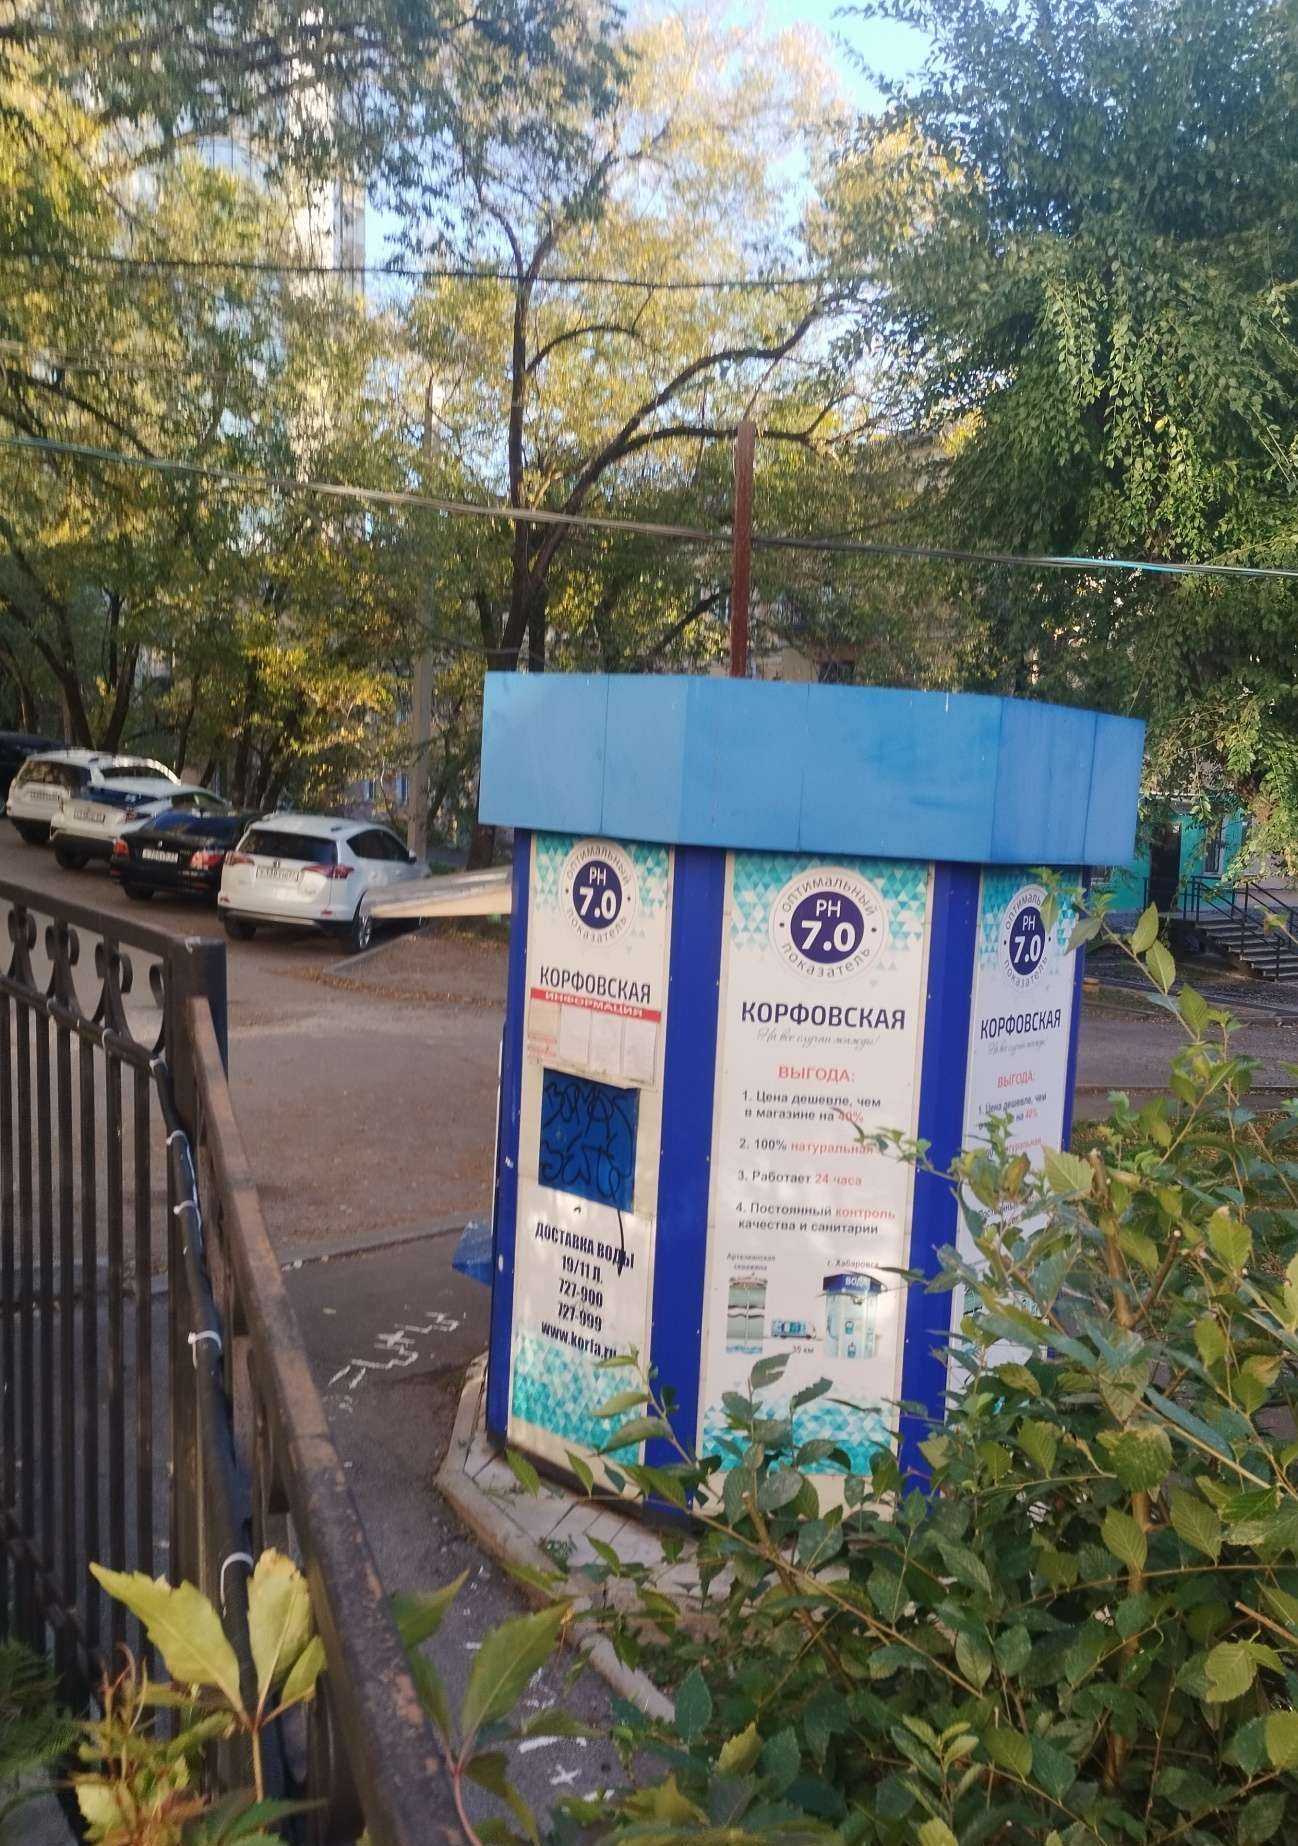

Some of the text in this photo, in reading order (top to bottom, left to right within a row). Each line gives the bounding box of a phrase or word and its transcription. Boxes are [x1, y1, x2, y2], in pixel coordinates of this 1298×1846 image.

[579, 886, 617, 920] 7.0
[801, 920, 856, 951] 7.0
[1014, 935, 1041, 964] 7.0
[539, 964, 651, 1005] КОРФОВСКАЯ
[544, 991, 643, 1018] ИНФОРМАЦИЯ
[741, 1001, 906, 1029] КОРФОВСКАЯ
[980, 1009, 1061, 1040] КОРФОВСКАЯ
[778, 1066, 855, 1083] ВЫГОДА:
[742, 1091, 881, 1107] 1. Цена дешевле, чем
[744, 1110, 752, 1118] в
[756, 1110, 816, 1121] магазине
[819, 1113, 834, 1121] на
[739, 1138, 750, 1149] 2.
[755, 1139, 787, 1151] 100%
[737, 1171, 862, 1186] 3. Работает 24 часа
[736, 1202, 896, 1221] 4. Постоянный контроль
[535, 1222, 594, 1256] ДОСТАВКА
[738, 1220, 878, 1235] качества и санитарии
